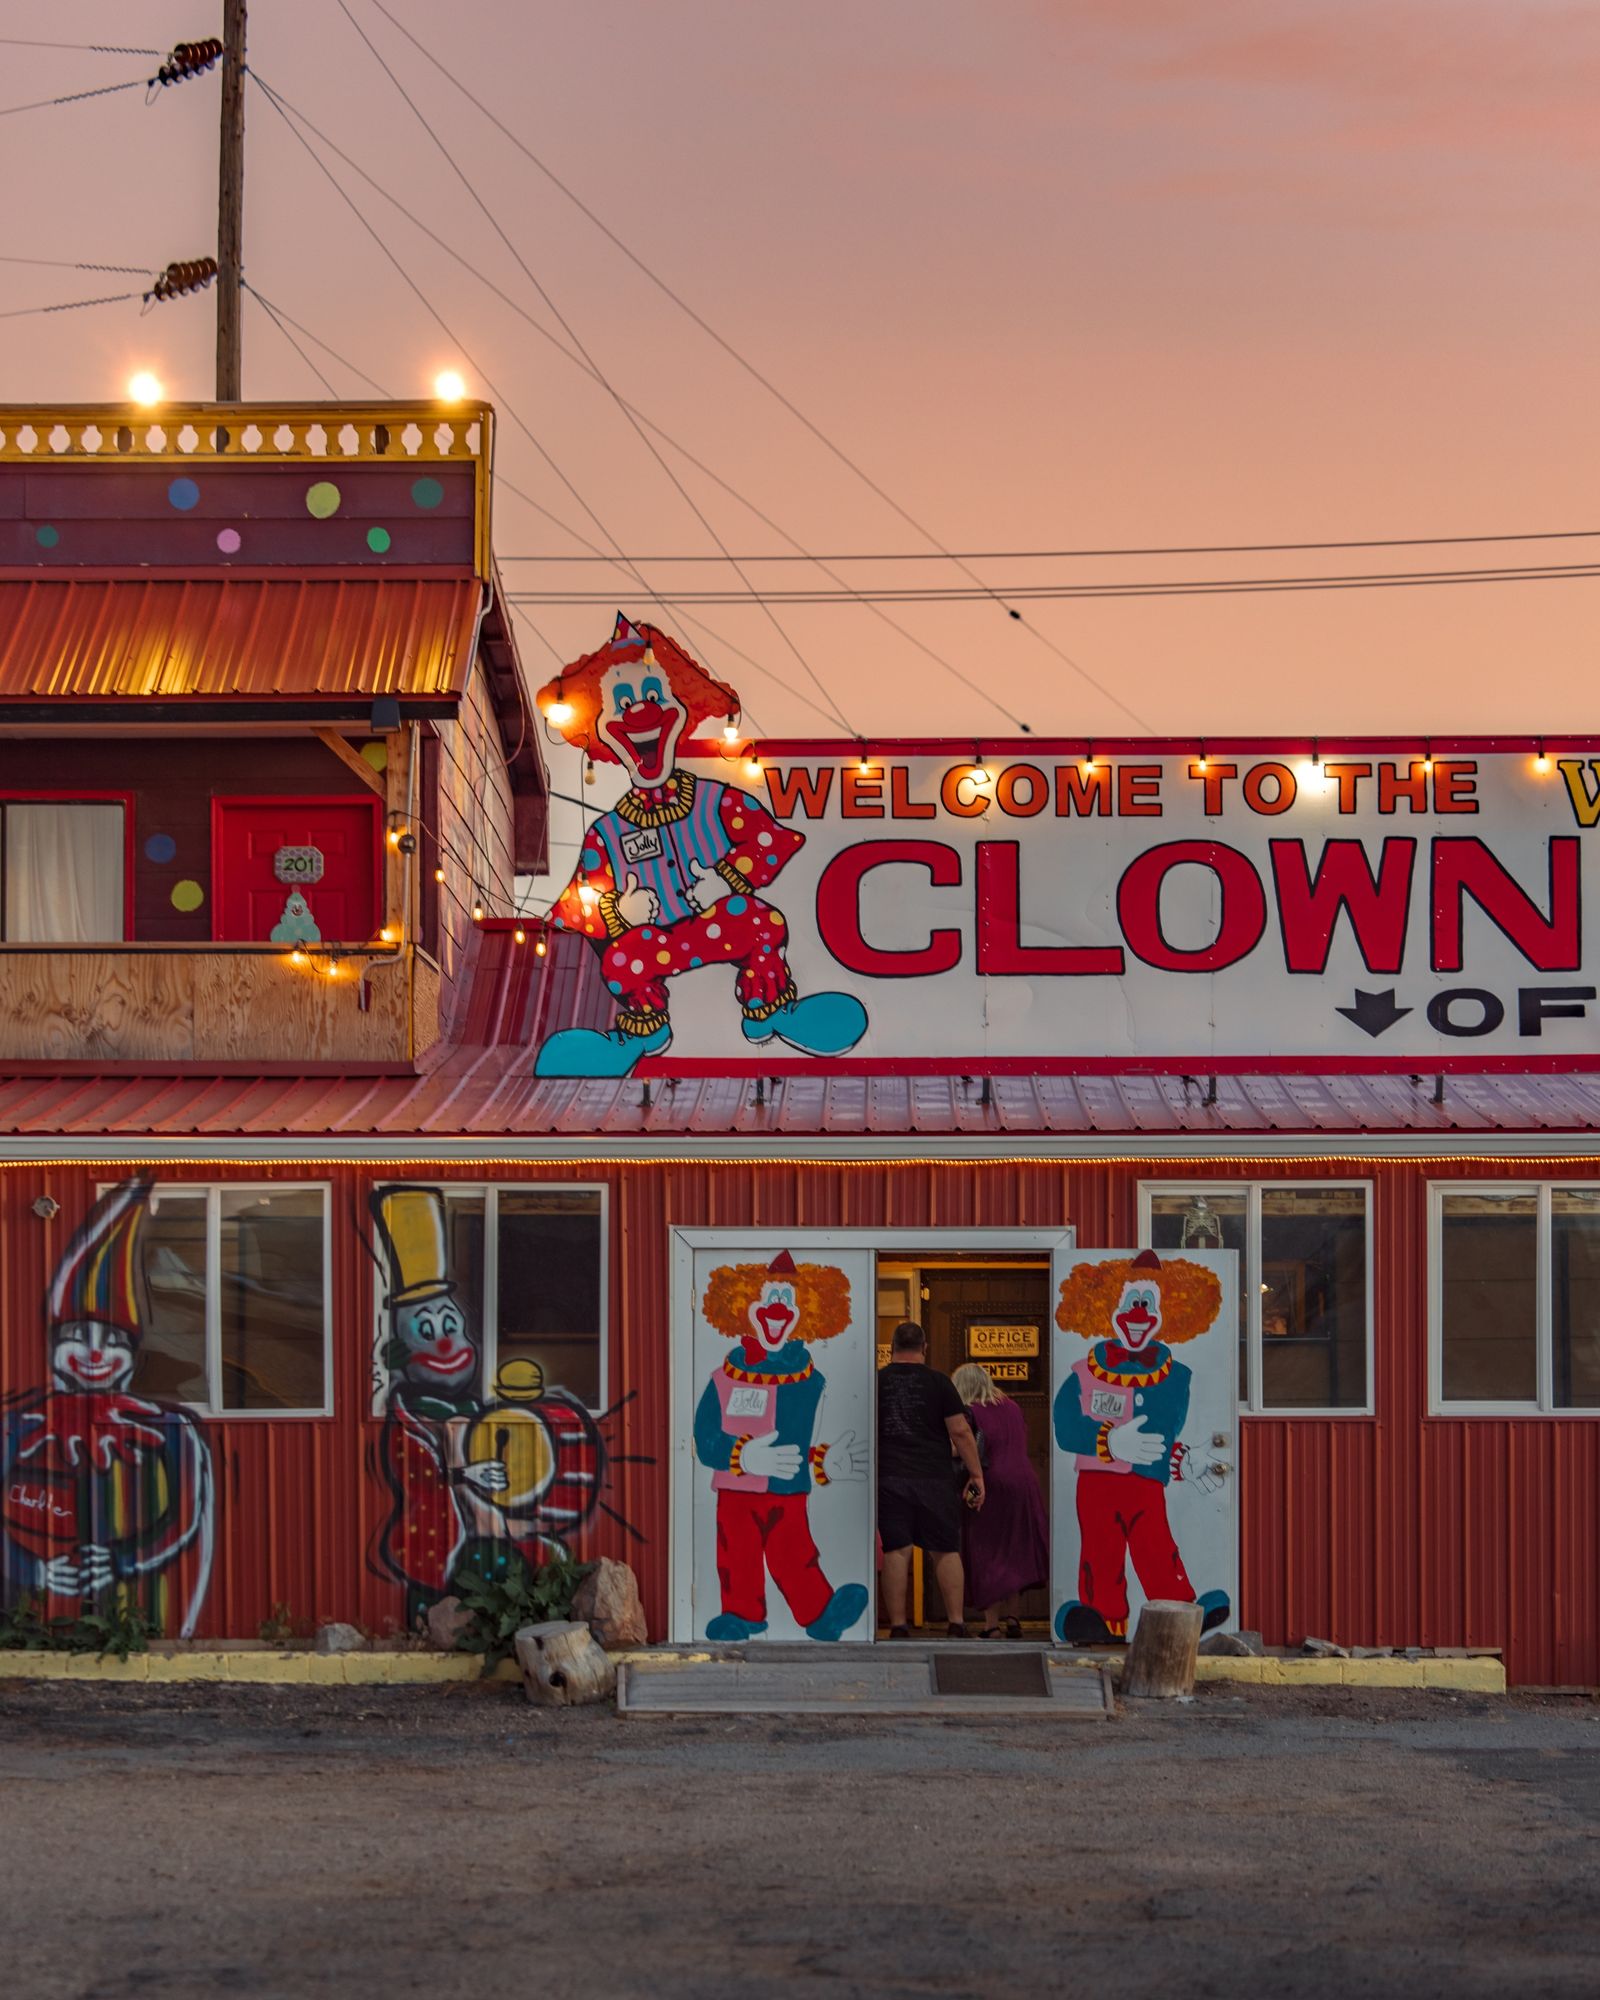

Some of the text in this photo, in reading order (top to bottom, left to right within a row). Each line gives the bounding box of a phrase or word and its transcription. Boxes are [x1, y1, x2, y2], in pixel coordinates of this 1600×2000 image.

[764, 763, 1163, 819] WELCOME
[1188, 762, 1298, 816] TO
[1324, 761, 1480, 814] THE
[624, 831, 659, 857] Jolly
[283, 856, 314, 873] 201
[815, 836, 1582, 979] CLOWN
[1426, 986, 1598, 1037] OF
[977, 1331, 1031, 1343] OFFICE
[733, 1389, 764, 1411] Jolly
